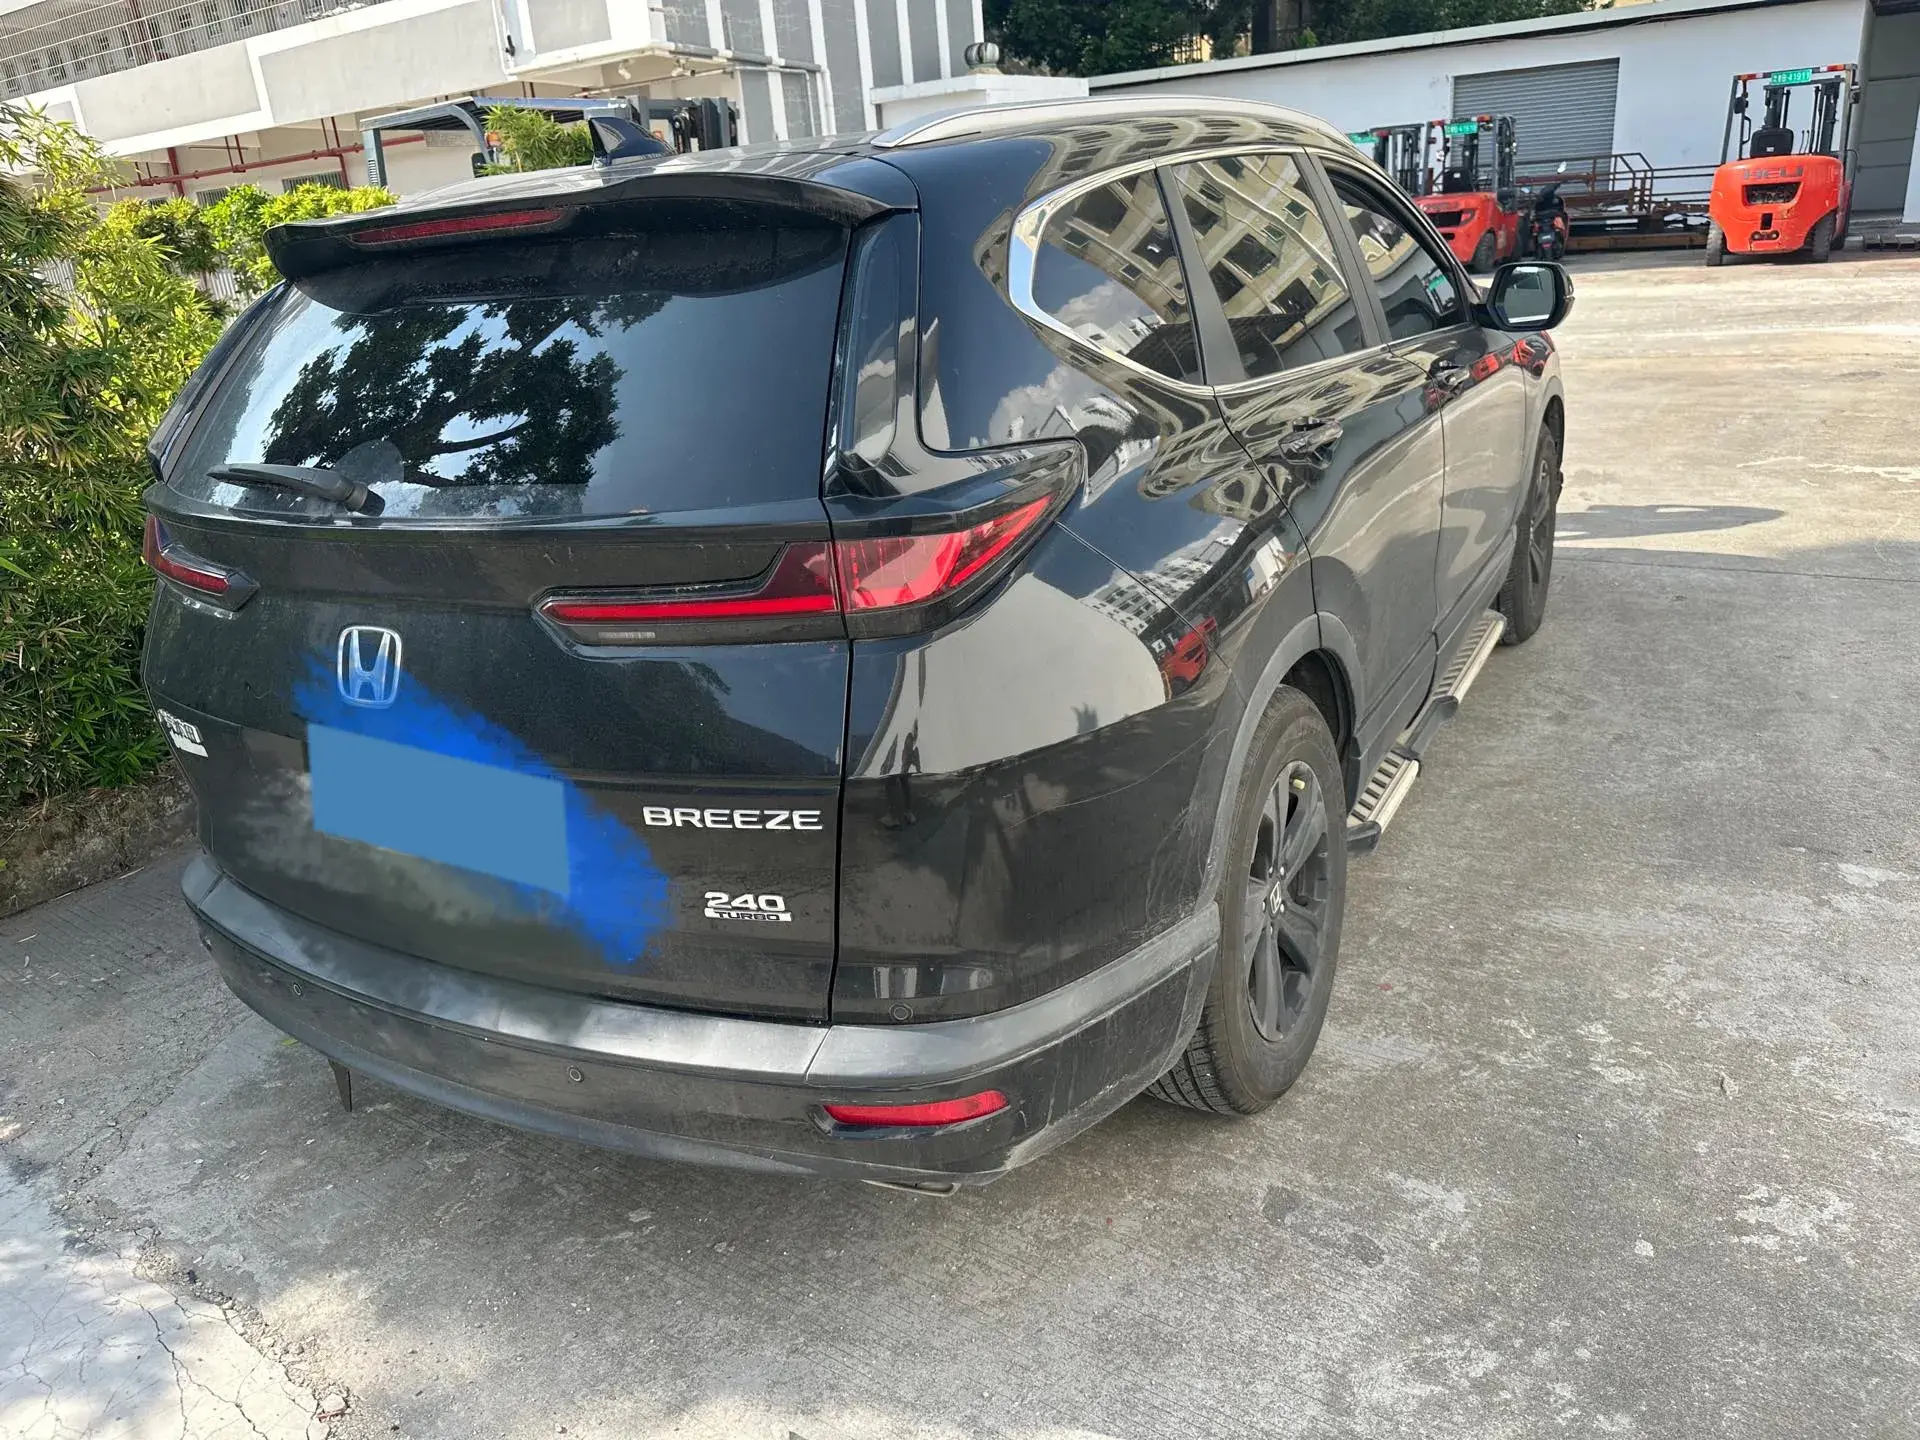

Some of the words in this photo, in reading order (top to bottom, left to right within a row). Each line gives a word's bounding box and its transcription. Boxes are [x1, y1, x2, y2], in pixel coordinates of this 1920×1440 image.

[642, 806, 823, 830] BREEZE
[704, 891, 786, 911] 240
[714, 911, 780, 921] TURBO
